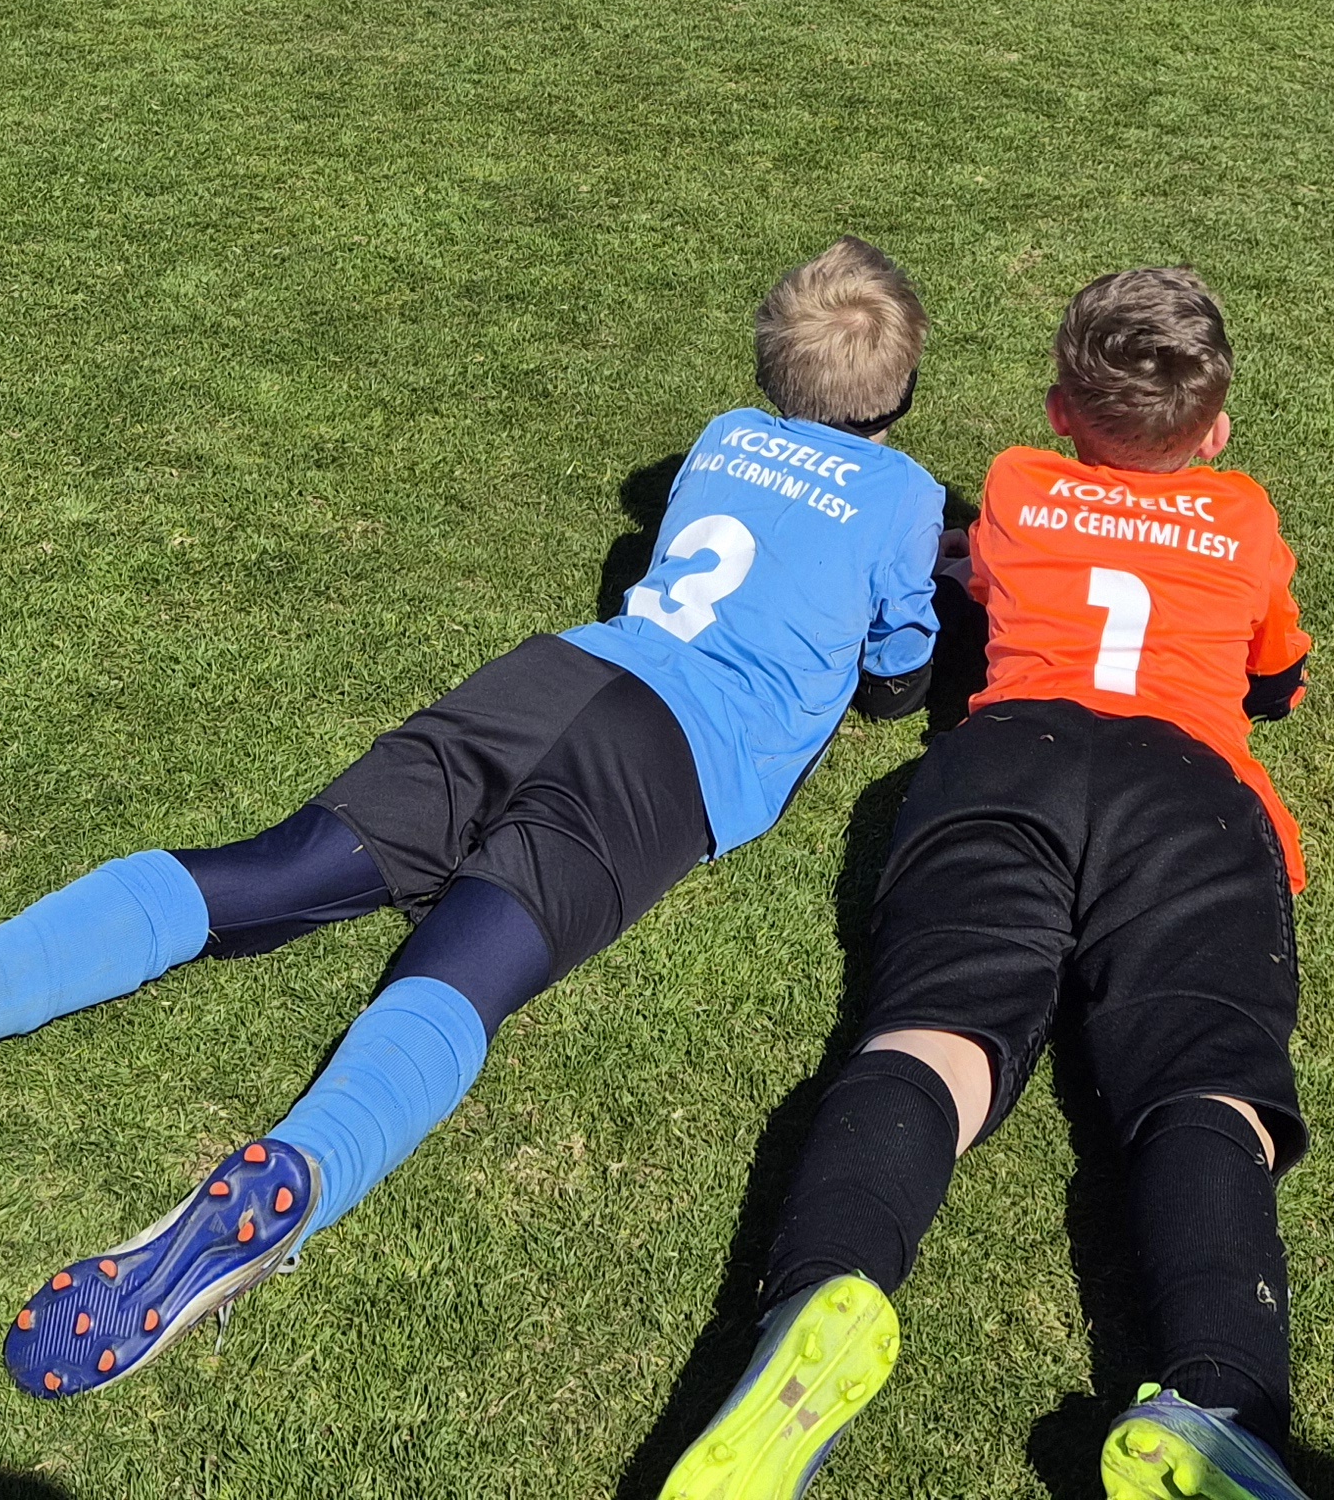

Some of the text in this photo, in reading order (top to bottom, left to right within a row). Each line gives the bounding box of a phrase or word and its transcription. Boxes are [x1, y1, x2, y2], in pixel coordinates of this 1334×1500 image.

[691, 452, 859, 525] NAD ČERNÝMI LESY
[721, 426, 861, 487] KOSTELEC
[1019, 505, 1240, 562] NAD ČERNÝMI LESY
[1087, 566, 1152, 696] 1
